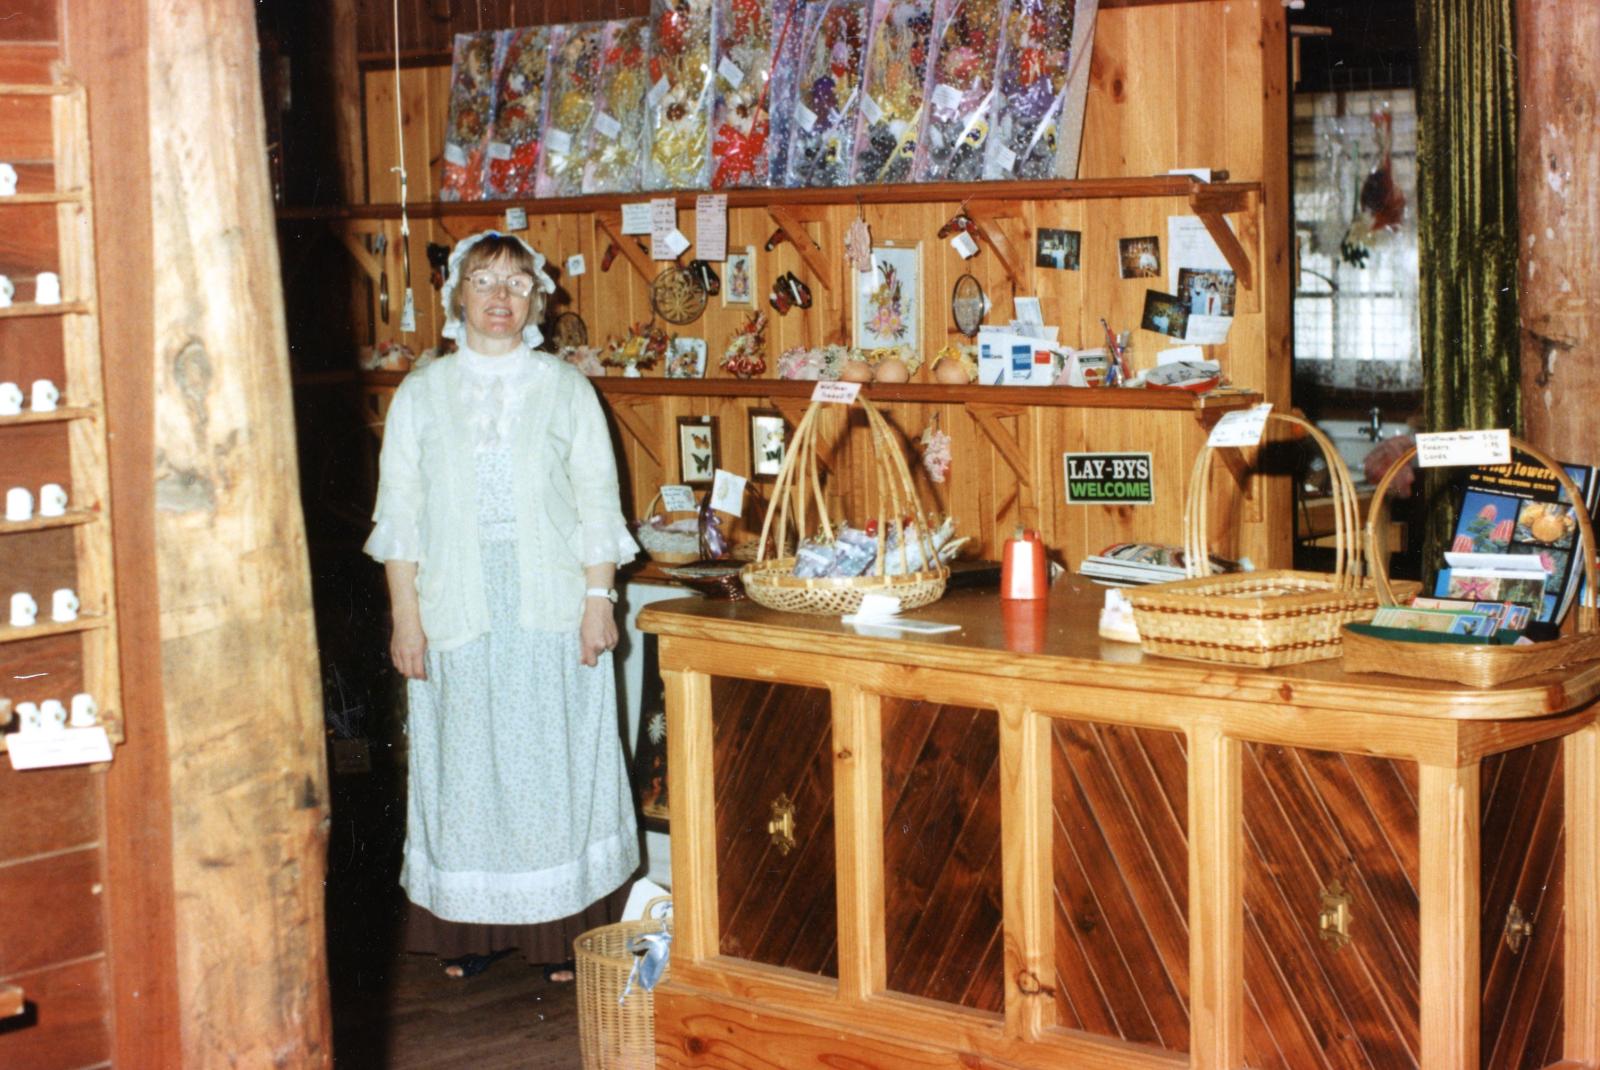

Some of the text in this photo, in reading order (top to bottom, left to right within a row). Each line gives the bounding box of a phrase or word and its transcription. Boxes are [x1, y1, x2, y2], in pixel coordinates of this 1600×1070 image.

[1069, 459, 1149, 480] LAY-BYS
[1482, 475, 1496, 483] THE
[1071, 481, 1150, 498] WELCOME
